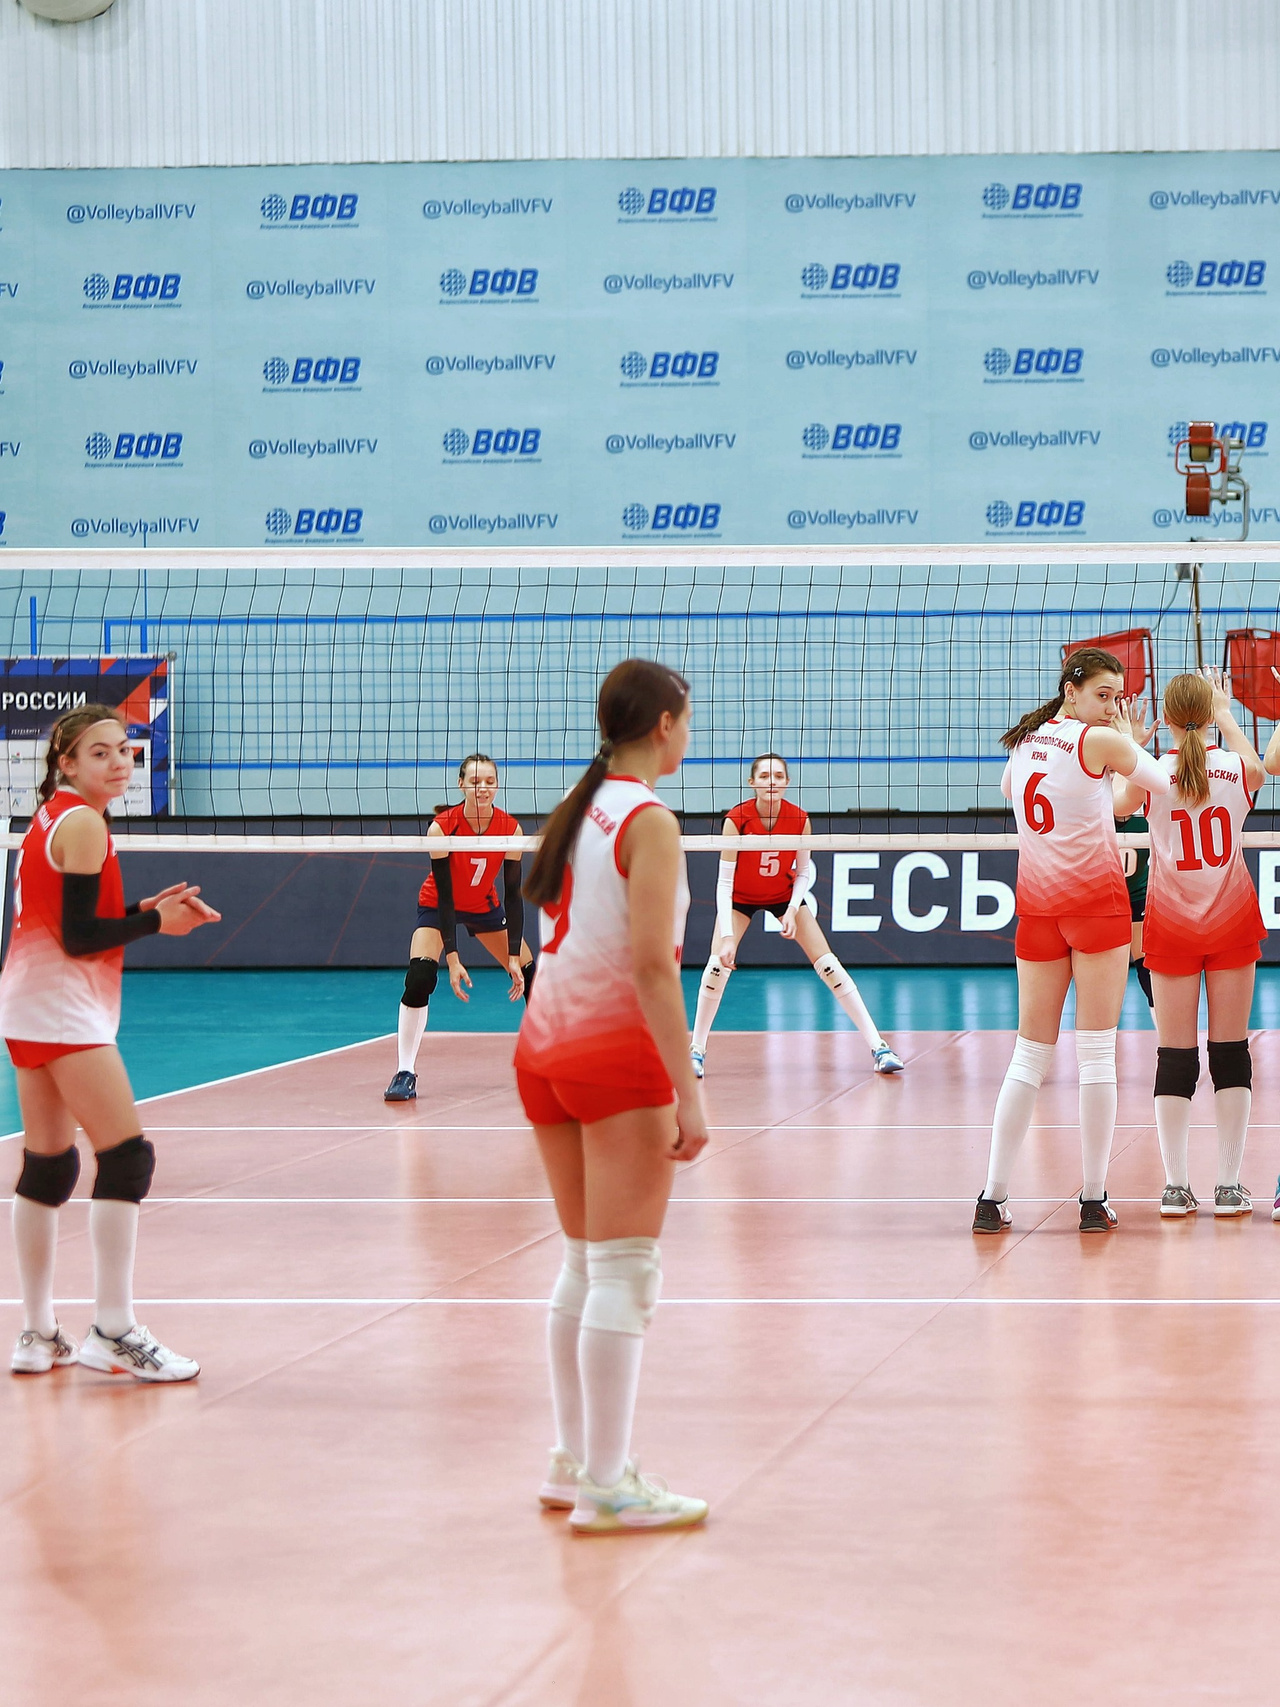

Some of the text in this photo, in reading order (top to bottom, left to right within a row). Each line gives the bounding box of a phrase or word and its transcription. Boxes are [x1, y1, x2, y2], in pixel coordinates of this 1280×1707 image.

[290, 194, 359, 221] ВФВ
[422, 197, 553, 220] @VolleyballVFV
[648, 187, 718, 214] ВФВ
[784, 192, 917, 214] @VolleyballVFV
[1012, 183, 1083, 210] ВФВ
[66, 203, 196, 225] @VolleyballVFV
[112, 273, 182, 300] ВФВ
[469, 268, 539, 296] ВФВ
[603, 272, 735, 295] @VolleyballVFV
[831, 263, 902, 290] ВФВ
[966, 269, 1100, 291] @VolleyballVFV
[1196, 260, 1267, 287] ВФВ
[246, 278, 376, 301] @VolleyballVFV
[68, 358, 198, 380] @VolleyballVFV
[292, 357, 362, 384] ВФВ
[425, 353, 556, 376] @VolleyballVFV
[650, 351, 720, 378] ВФВ
[785, 349, 918, 371] @VolleyballVFV
[1014, 348, 1085, 375] ВФВ
[114, 432, 184, 459] ВФВ
[248, 437, 378, 460] @VolleyballVFV
[472, 428, 542, 455] ВФВ
[605, 432, 737, 455] @VolleyballVFV
[832, 423, 903, 450] ВФВ
[968, 429, 1101, 451] @VolleyballVFV
[70, 516, 200, 539] @VolleyballVFV
[295, 508, 365, 536] ВФВ
[427, 513, 559, 536] @VolleyballVFV
[652, 503, 722, 530] ВФВ
[786, 508, 919, 531] @VolleyballVFV
[1015, 500, 1086, 528] ВФВ
[2, 691, 87, 711] РОССИИ
[1023, 772, 1055, 835] 6
[1170, 805, 1232, 872] 10
[470, 857, 487, 887] 7
[758, 851, 780, 877] 5
